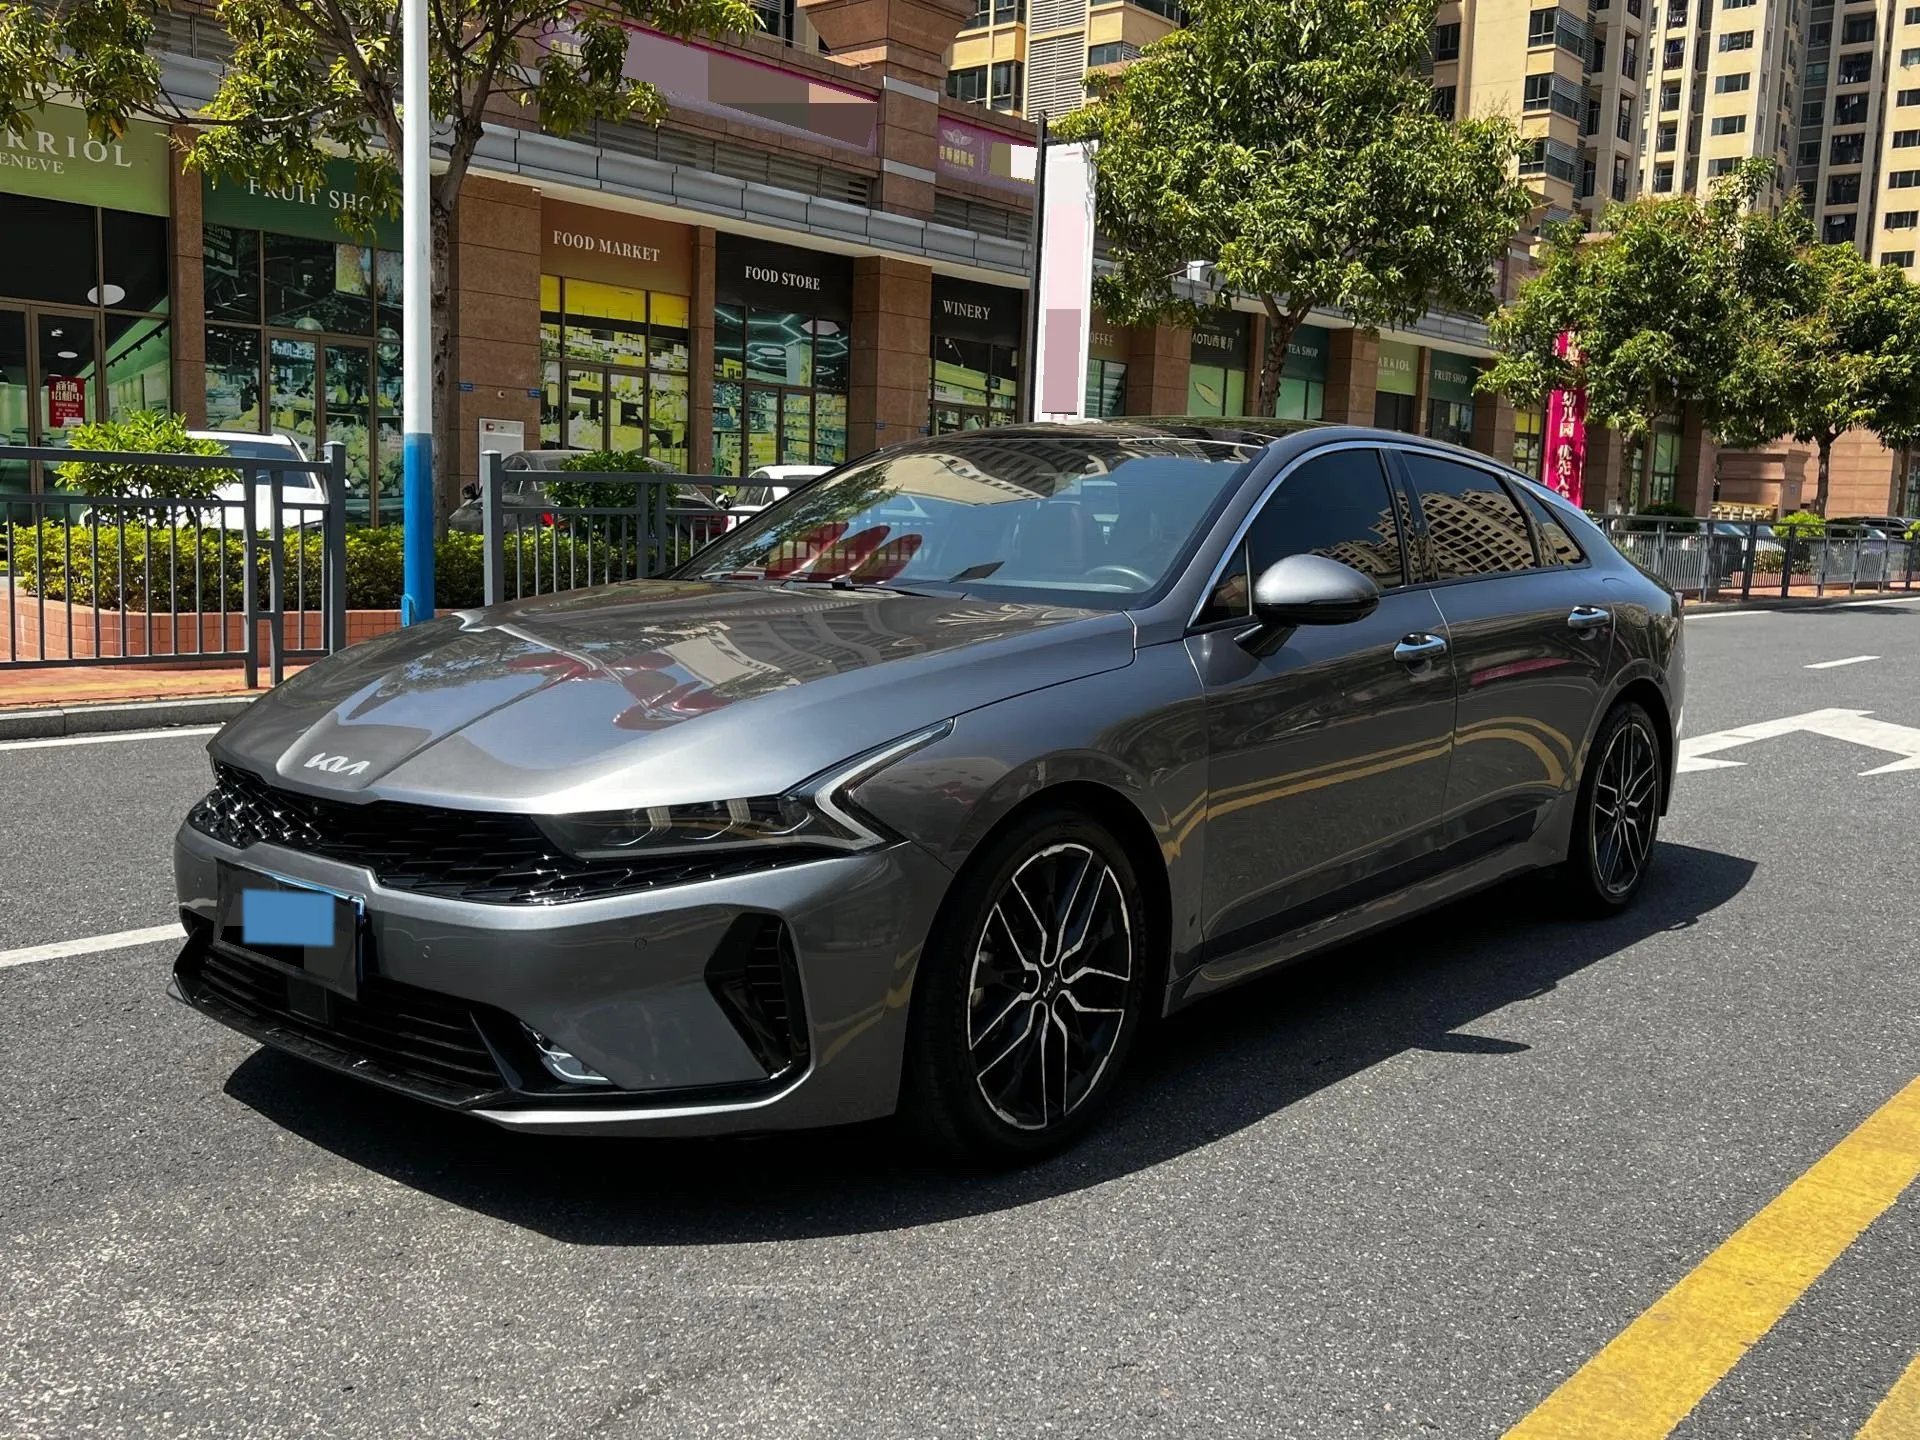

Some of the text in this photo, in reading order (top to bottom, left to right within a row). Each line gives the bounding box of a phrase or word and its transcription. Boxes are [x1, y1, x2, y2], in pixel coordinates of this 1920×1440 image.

[553, 230, 660, 262] FOOD MARKET
[745, 265, 820, 291] FOOD STORE
[943, 300, 991, 320] WINERY
[1287, 343, 1319, 358] TEA SHOP
[1434, 369, 1468, 384] FRUIT SHOP
[1559, 391, 1577, 438] 幼儿园
